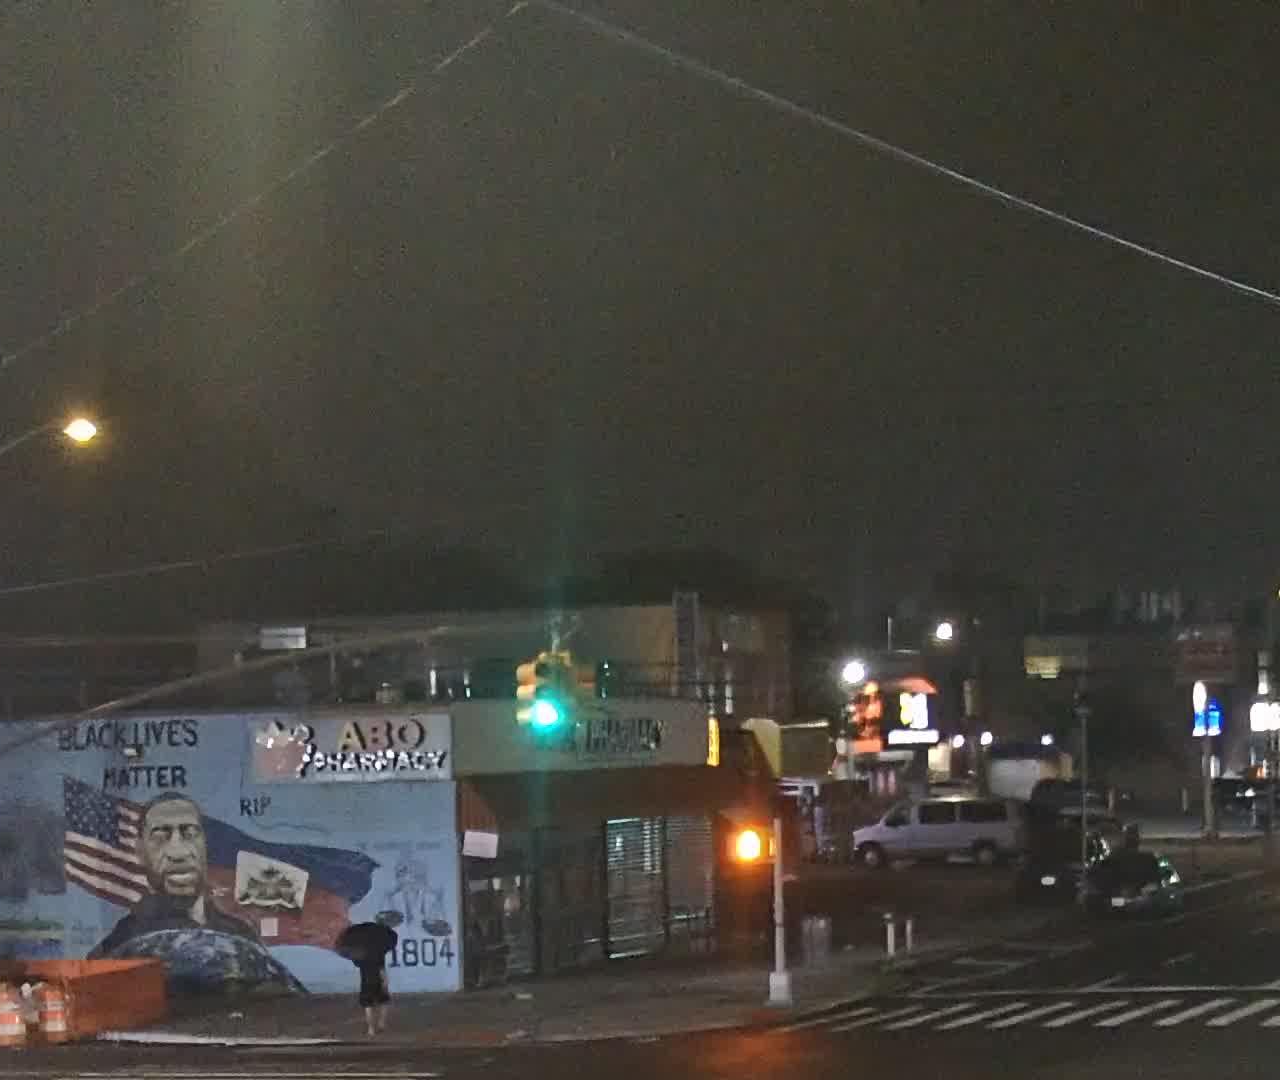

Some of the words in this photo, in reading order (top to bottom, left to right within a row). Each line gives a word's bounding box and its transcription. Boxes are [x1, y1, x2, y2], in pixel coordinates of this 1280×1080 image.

[58, 719, 126, 751] BLACK
[132, 719, 199, 747] LIVES
[339, 717, 426, 751] ABO
[312, 749, 448, 773] PHARMACY
[103, 765, 187, 788] MATTER
[240, 797, 271, 816] RIP
[389, 939, 455, 967] 1804
